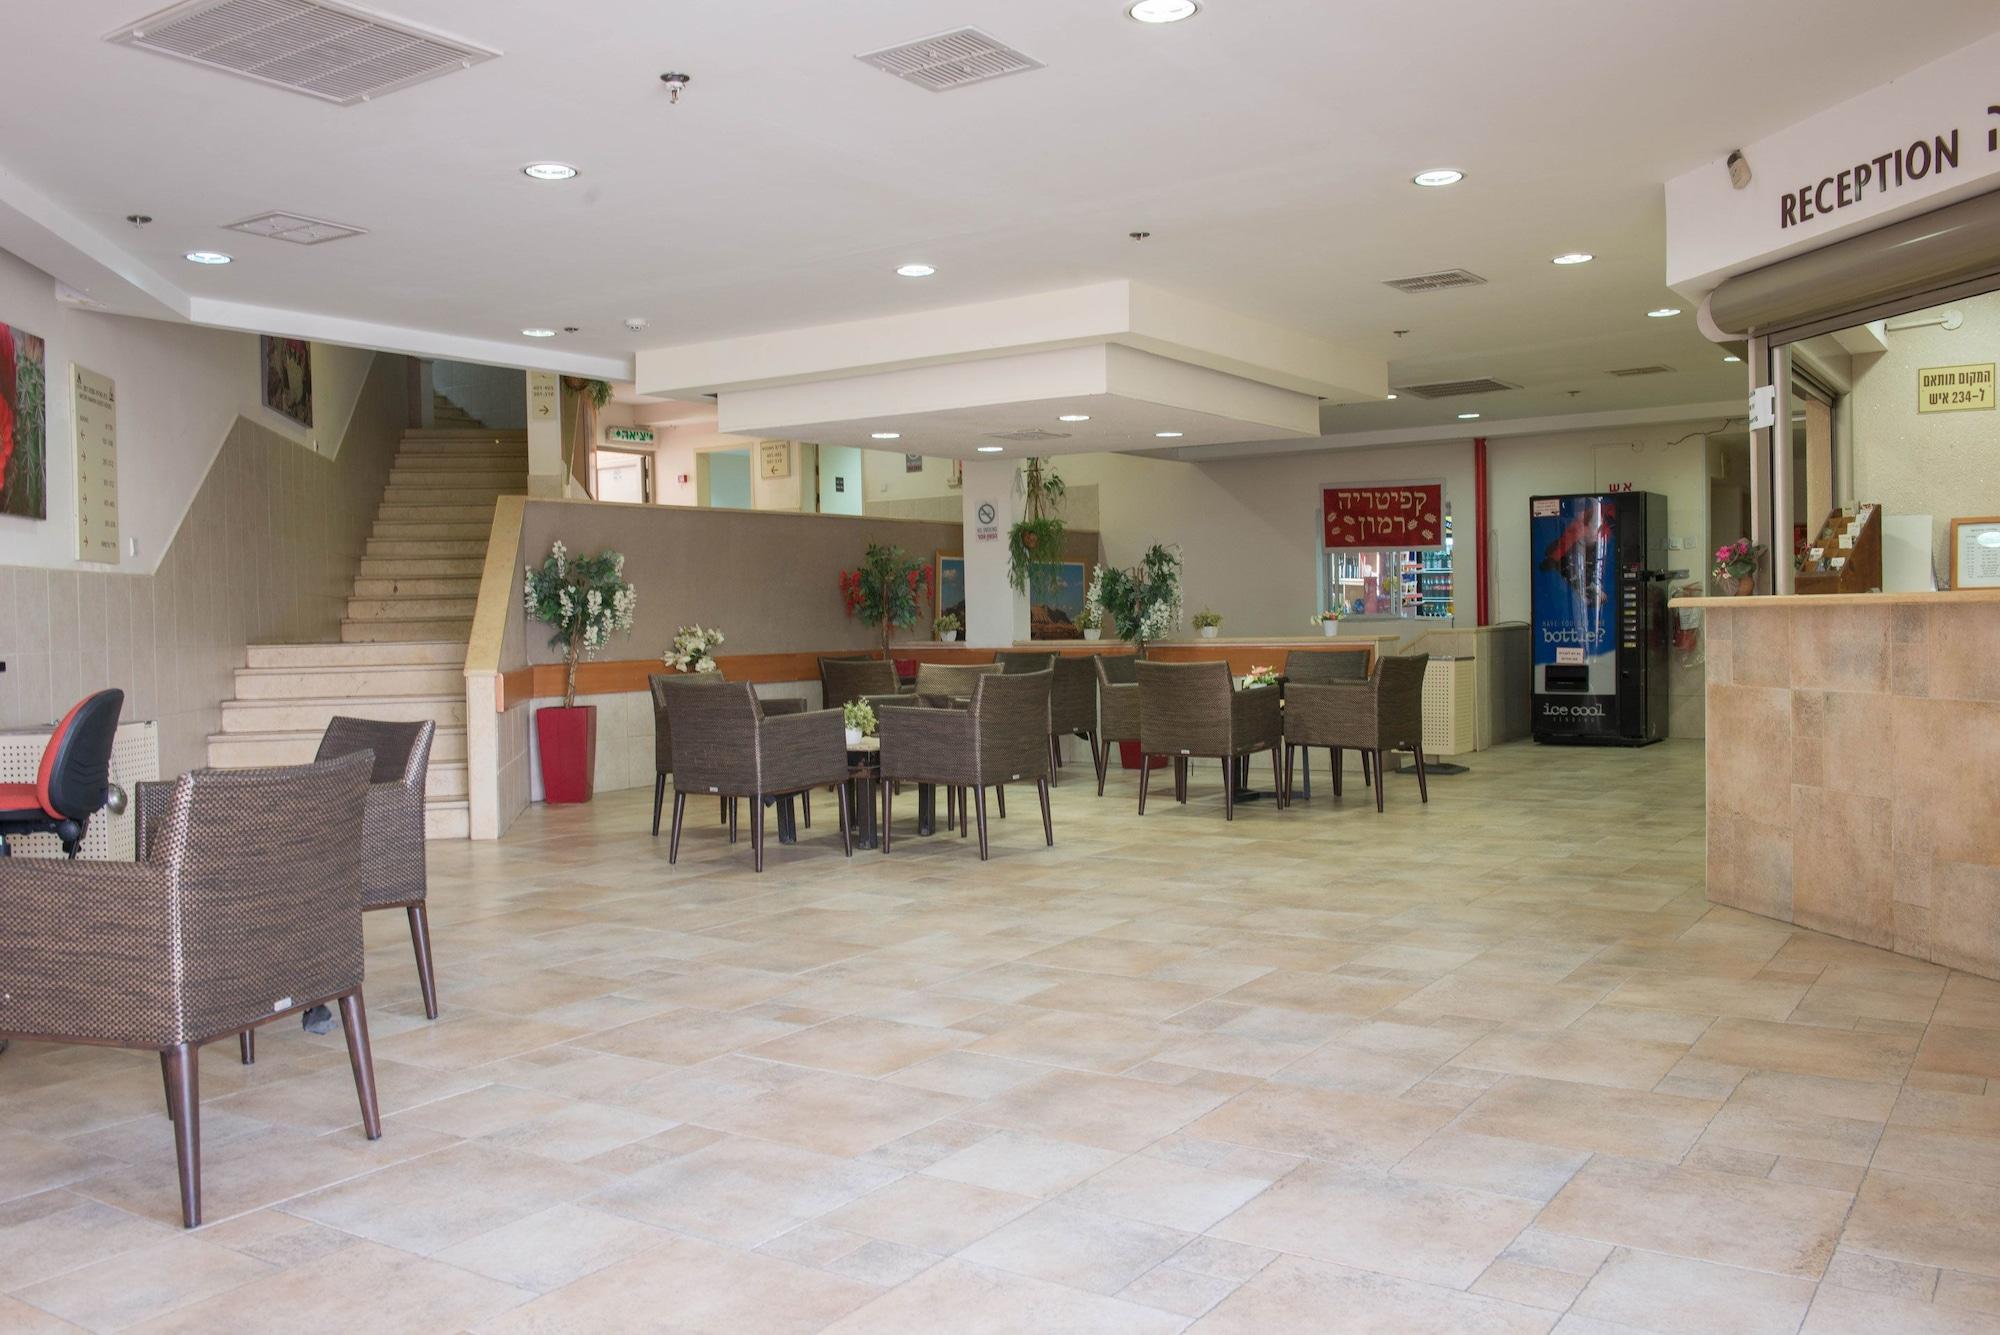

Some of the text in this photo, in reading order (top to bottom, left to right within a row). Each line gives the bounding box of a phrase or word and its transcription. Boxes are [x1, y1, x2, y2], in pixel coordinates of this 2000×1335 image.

[1781, 129, 1959, 229] RECEPTION
[1923, 370, 1991, 387] המקום מותאם
[1929, 392, 1949, 405] איש
[621, 430, 650, 441] יציאה
[1338, 491, 1427, 517] קפיטריה
[1358, 516, 1406, 540] רמון
[1542, 628, 1606, 643] bottle?
[1543, 702, 1606, 716] ice cool
